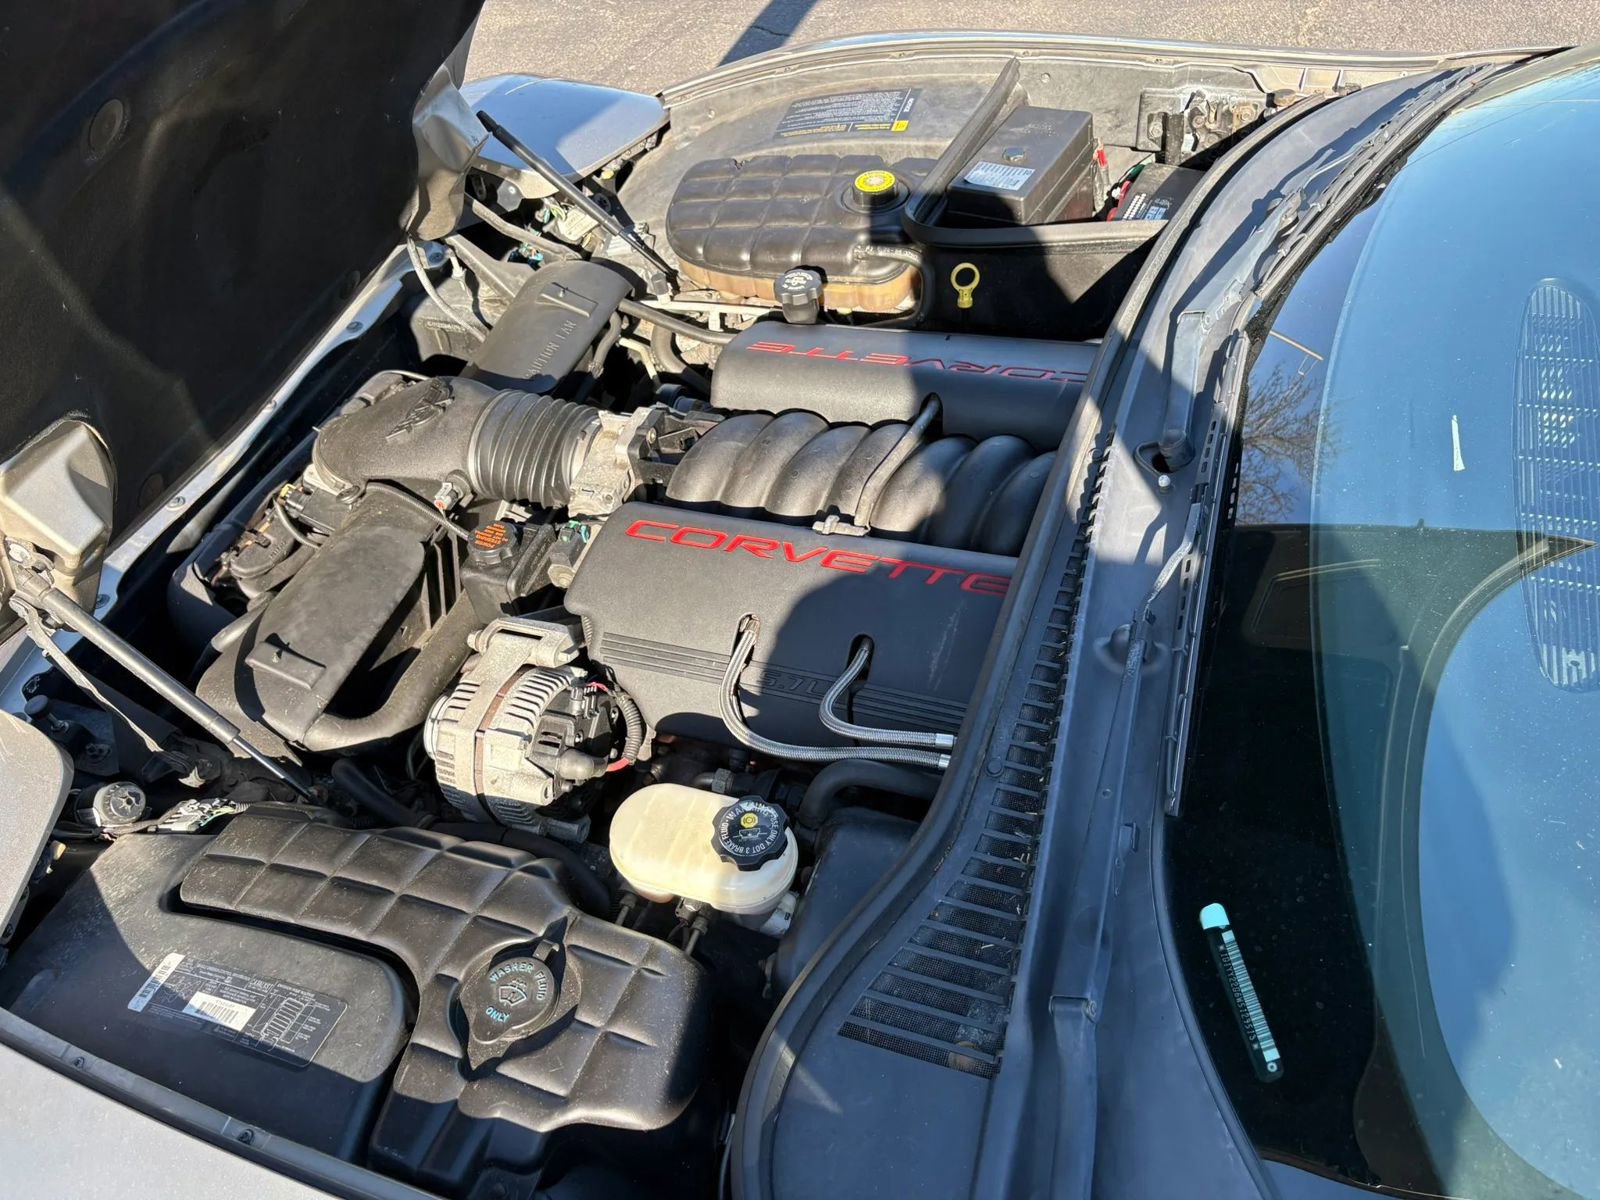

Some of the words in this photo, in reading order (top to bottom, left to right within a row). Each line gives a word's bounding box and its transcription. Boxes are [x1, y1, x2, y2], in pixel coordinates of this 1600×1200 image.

[624, 518, 1010, 597] CORVETTE
[720, 822, 729, 841] FLUID
[766, 829, 778, 846] ONLY
[724, 838, 743, 853] BRAKE
[752, 845, 766, 854] DOT
[490, 962, 534, 982] WASHER
[535, 971, 547, 1000] FLUID
[485, 1006, 509, 1022] ONLY
